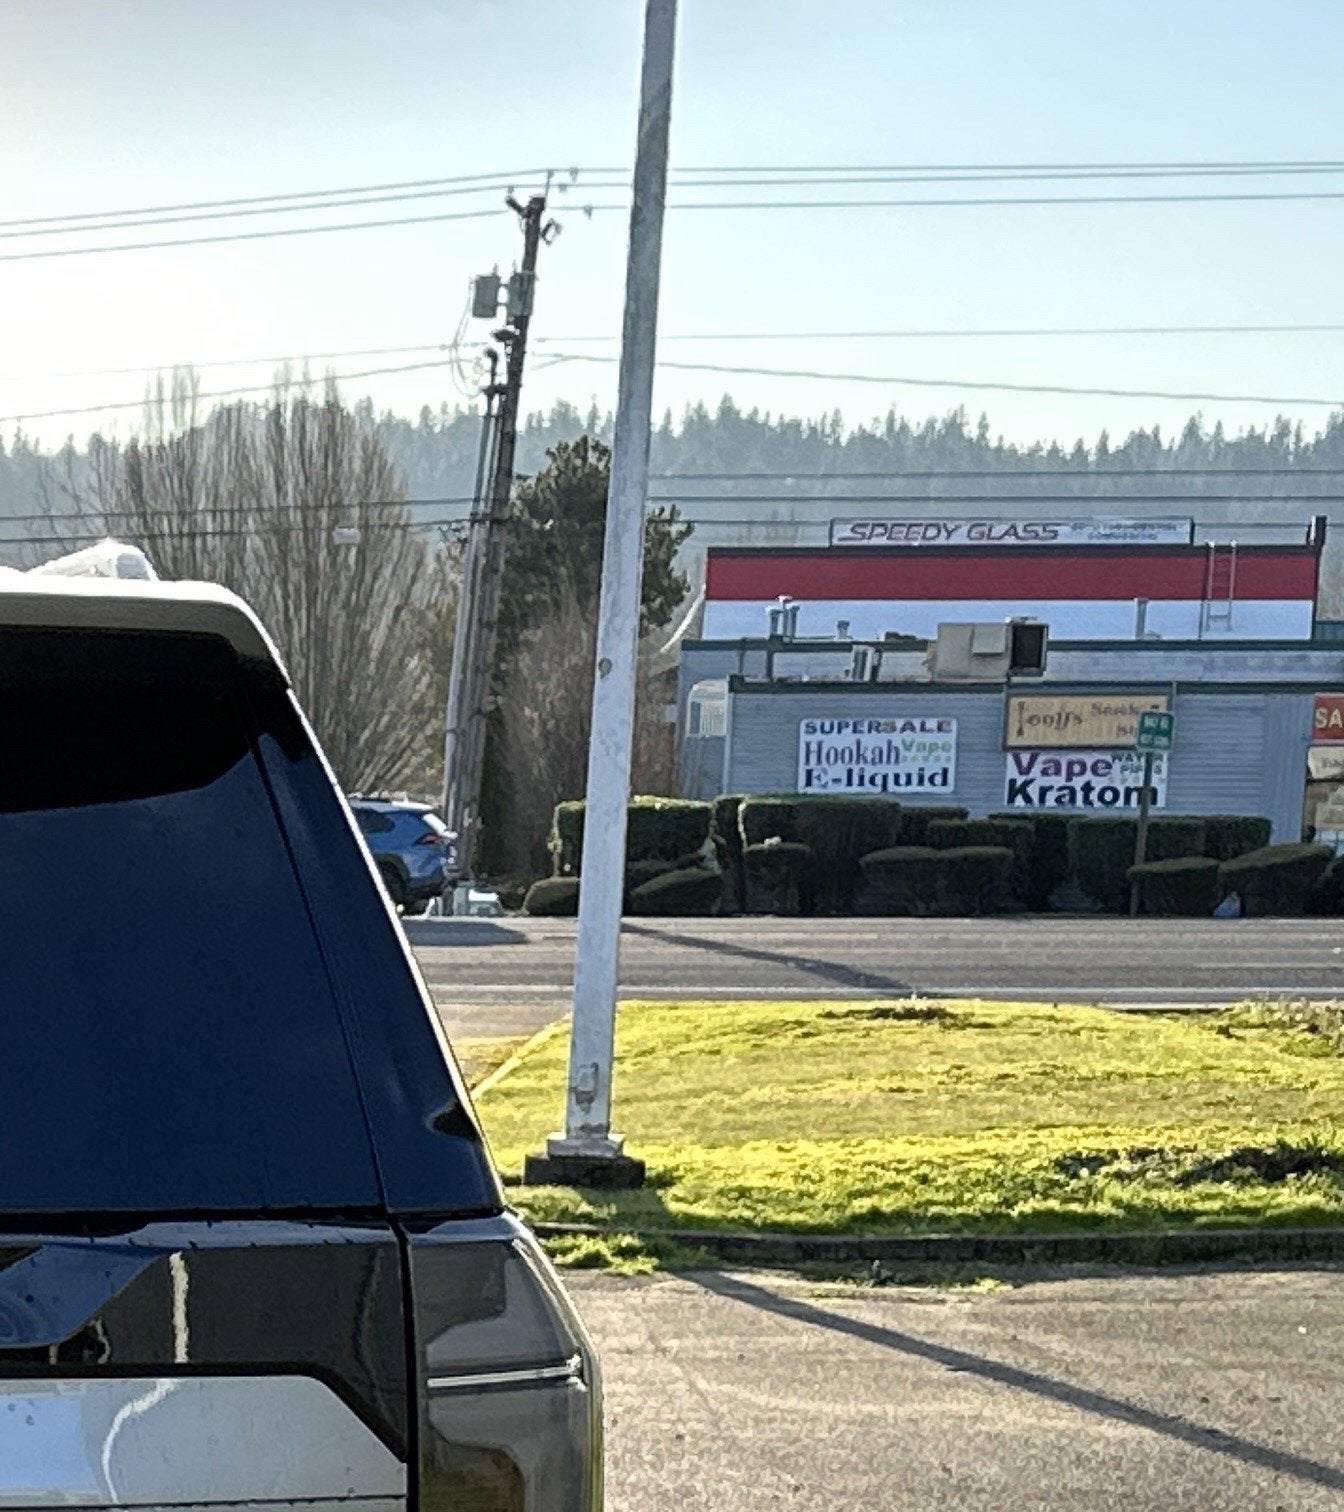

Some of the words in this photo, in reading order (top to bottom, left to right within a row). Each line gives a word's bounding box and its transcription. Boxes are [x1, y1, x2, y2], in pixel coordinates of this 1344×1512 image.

[838, 522, 961, 541] SPEEDY
[967, 522, 1060, 540] GLASS
[804, 738, 901, 766] Hookah
[901, 738, 952, 756] Vape
[805, 767, 950, 792] E-liquid
[1012, 751, 1112, 782] Vape
[1006, 778, 1159, 806] Kratom
